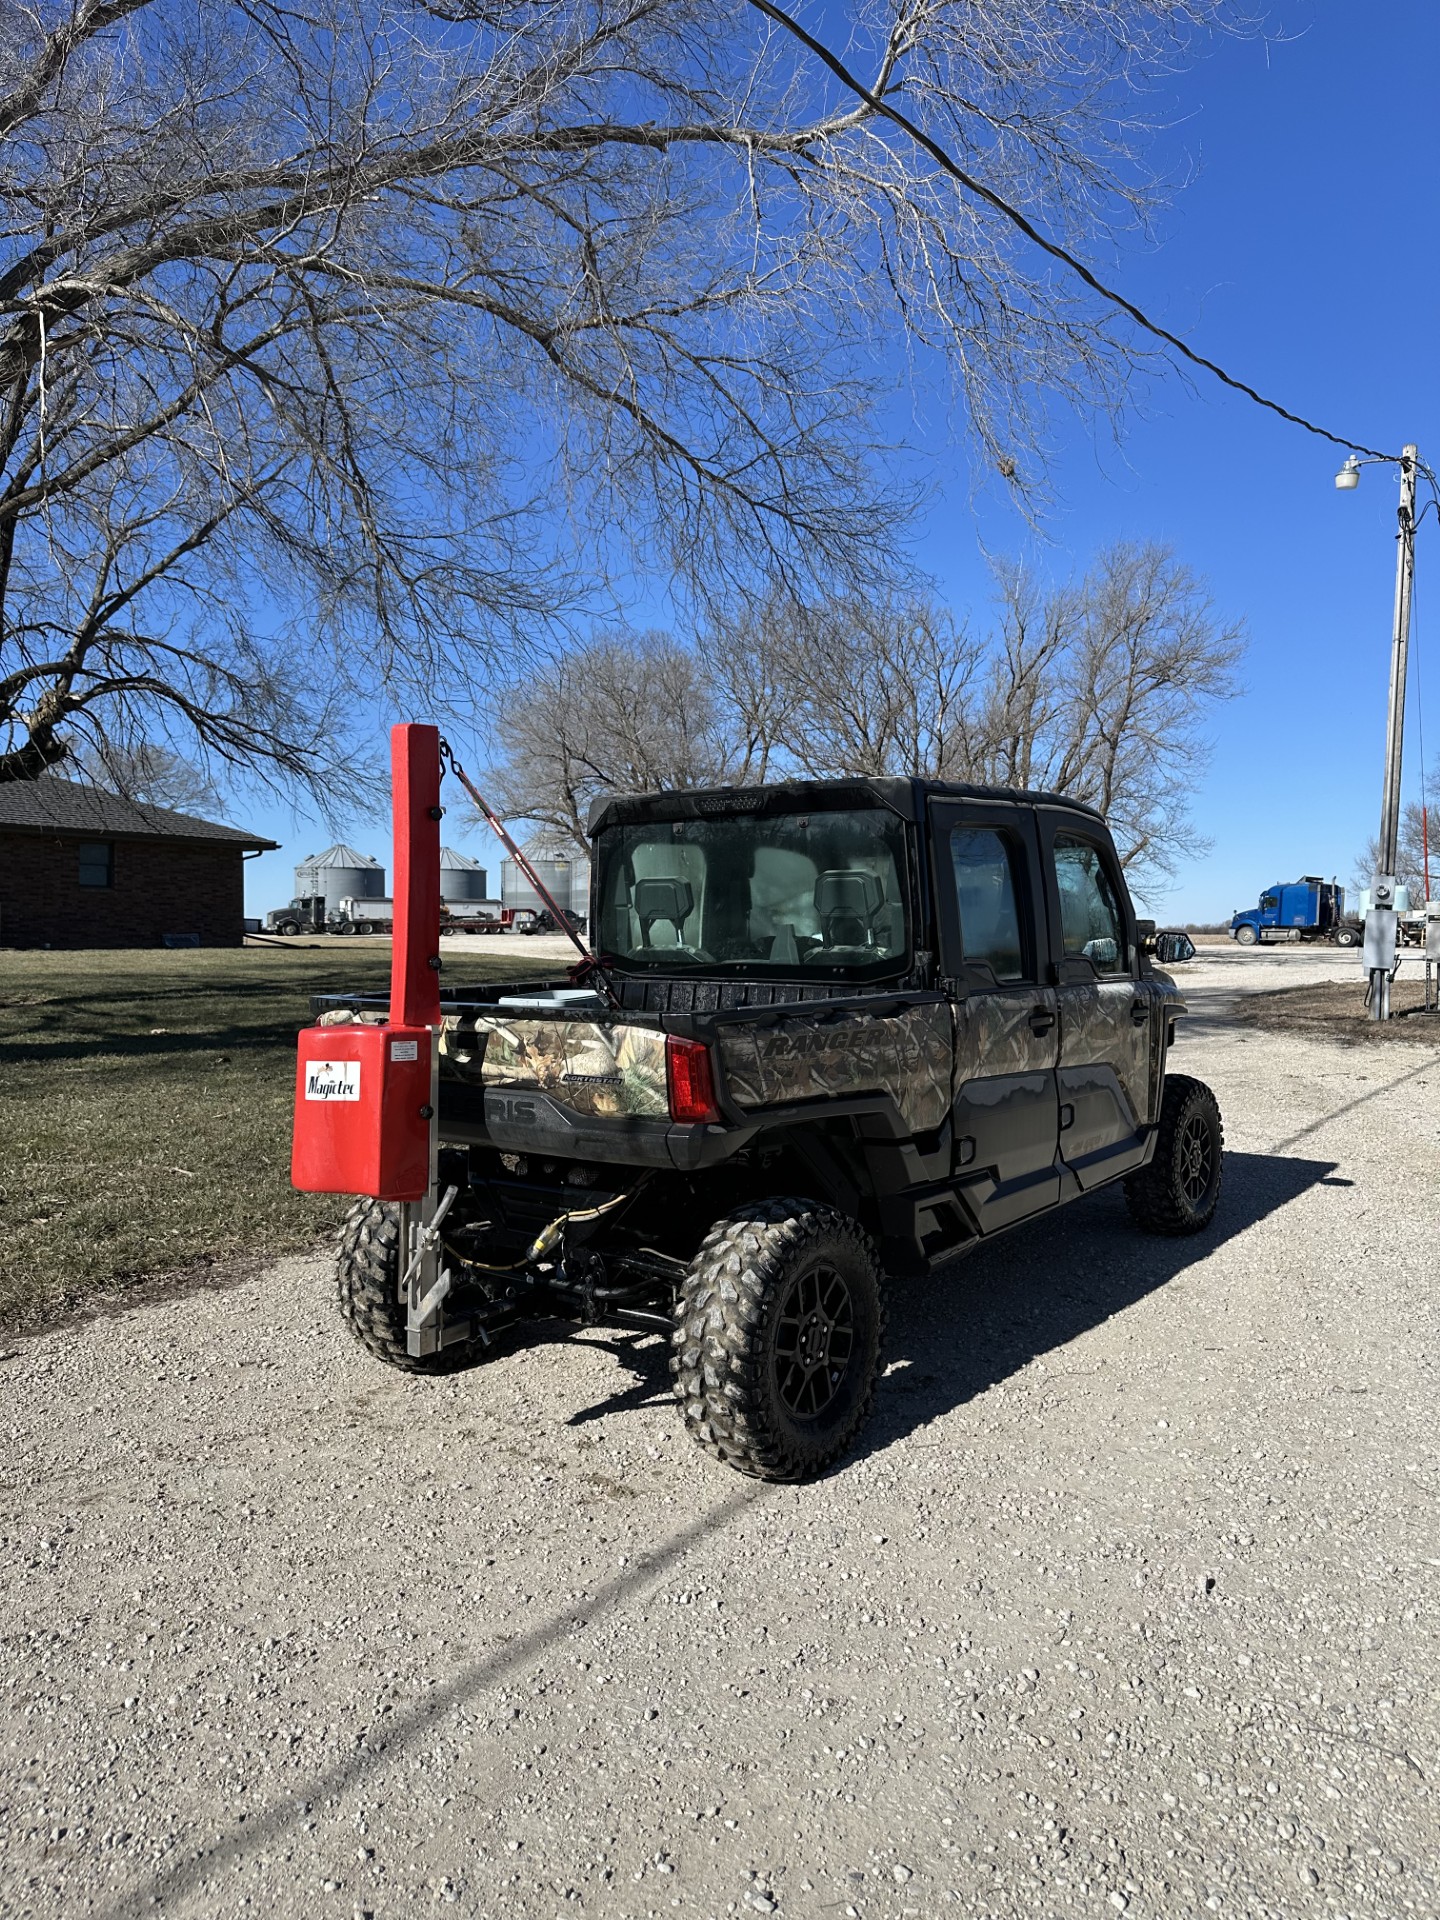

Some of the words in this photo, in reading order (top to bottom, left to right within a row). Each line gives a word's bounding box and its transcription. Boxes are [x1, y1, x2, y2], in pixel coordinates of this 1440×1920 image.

[762, 1028, 886, 1057] RANGER
[307, 1075, 355, 1100] Magictec
[564, 1074, 622, 1085] NORTHSTAR
[484, 1097, 536, 1125] RIS
